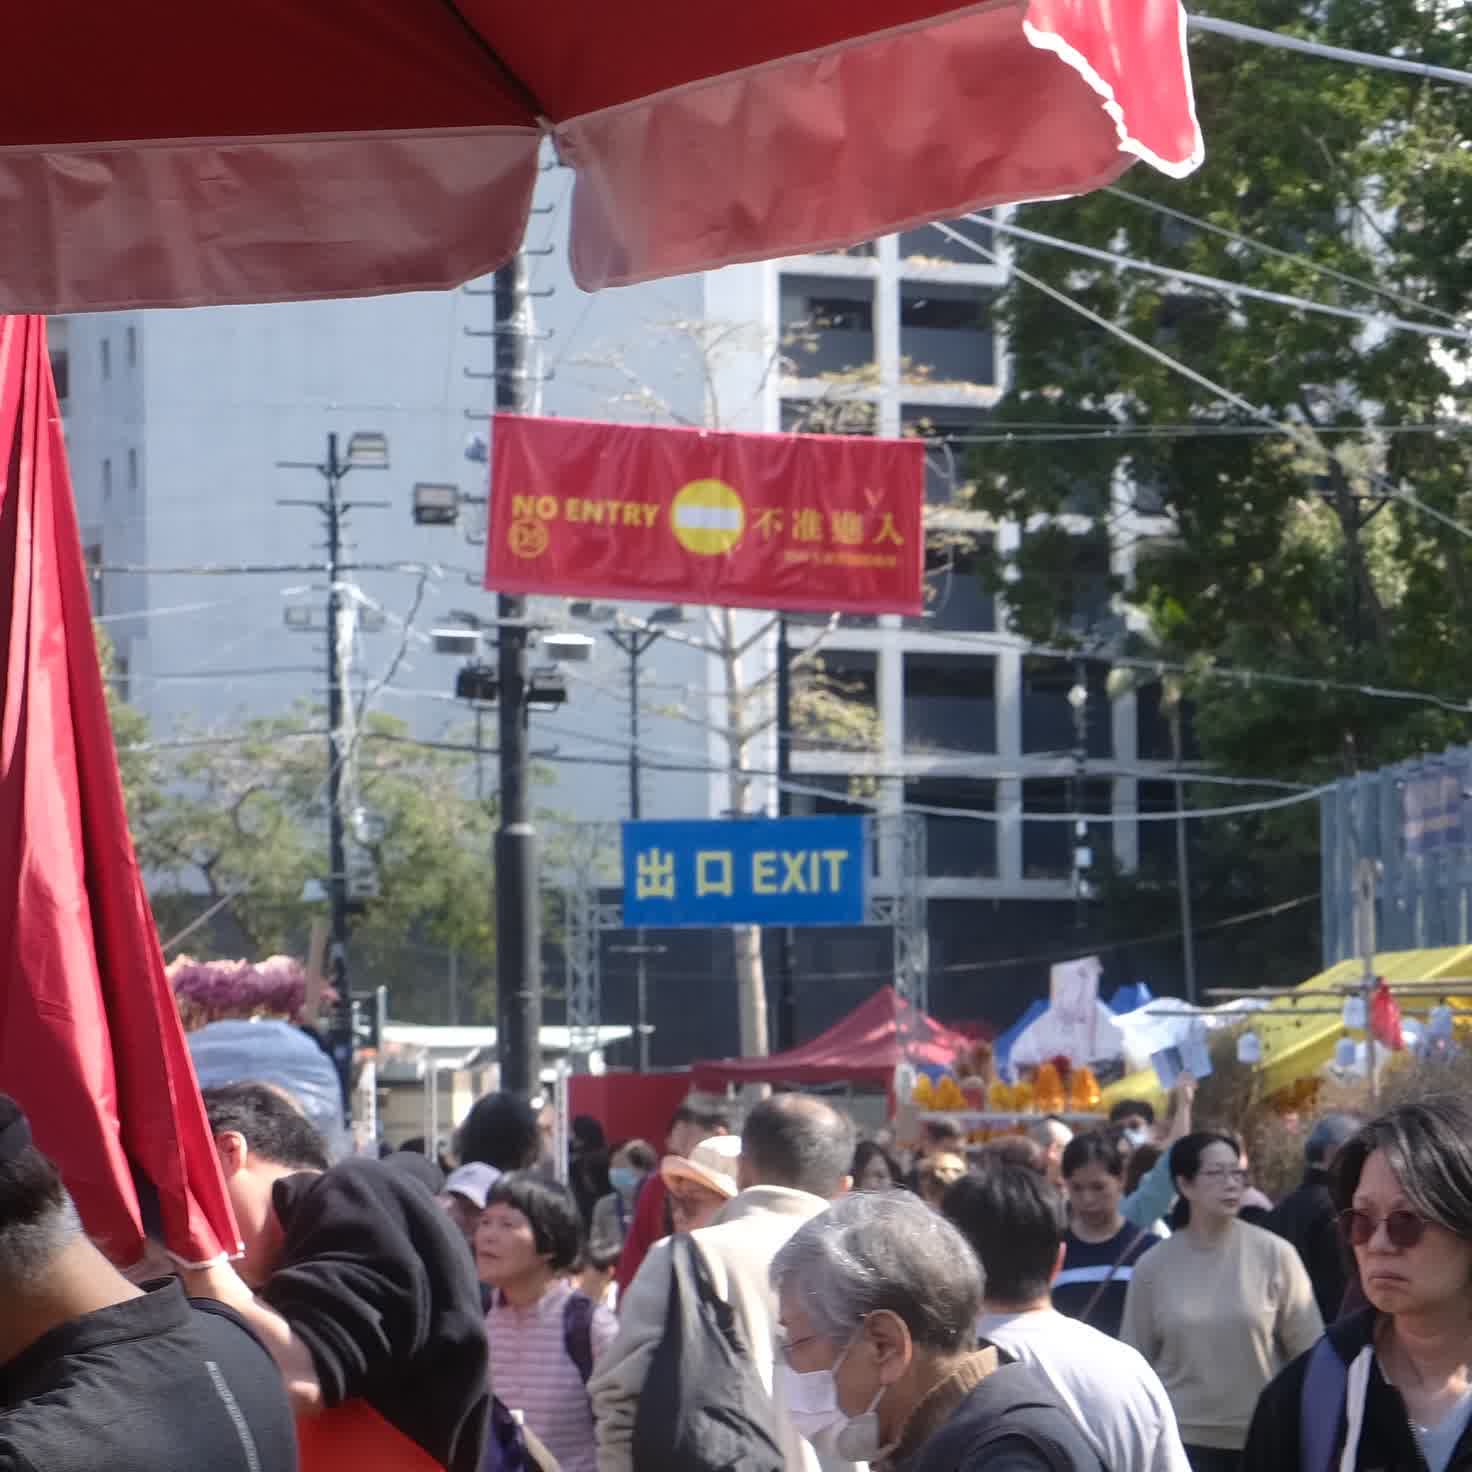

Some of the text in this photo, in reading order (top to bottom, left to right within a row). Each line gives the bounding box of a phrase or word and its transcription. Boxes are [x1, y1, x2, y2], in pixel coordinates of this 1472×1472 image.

[511, 495, 660, 528] NO ENTRY
[751, 507, 905, 546] 不准進入
[636, 847, 734, 900] 出口
[752, 849, 850, 895] EXIT
